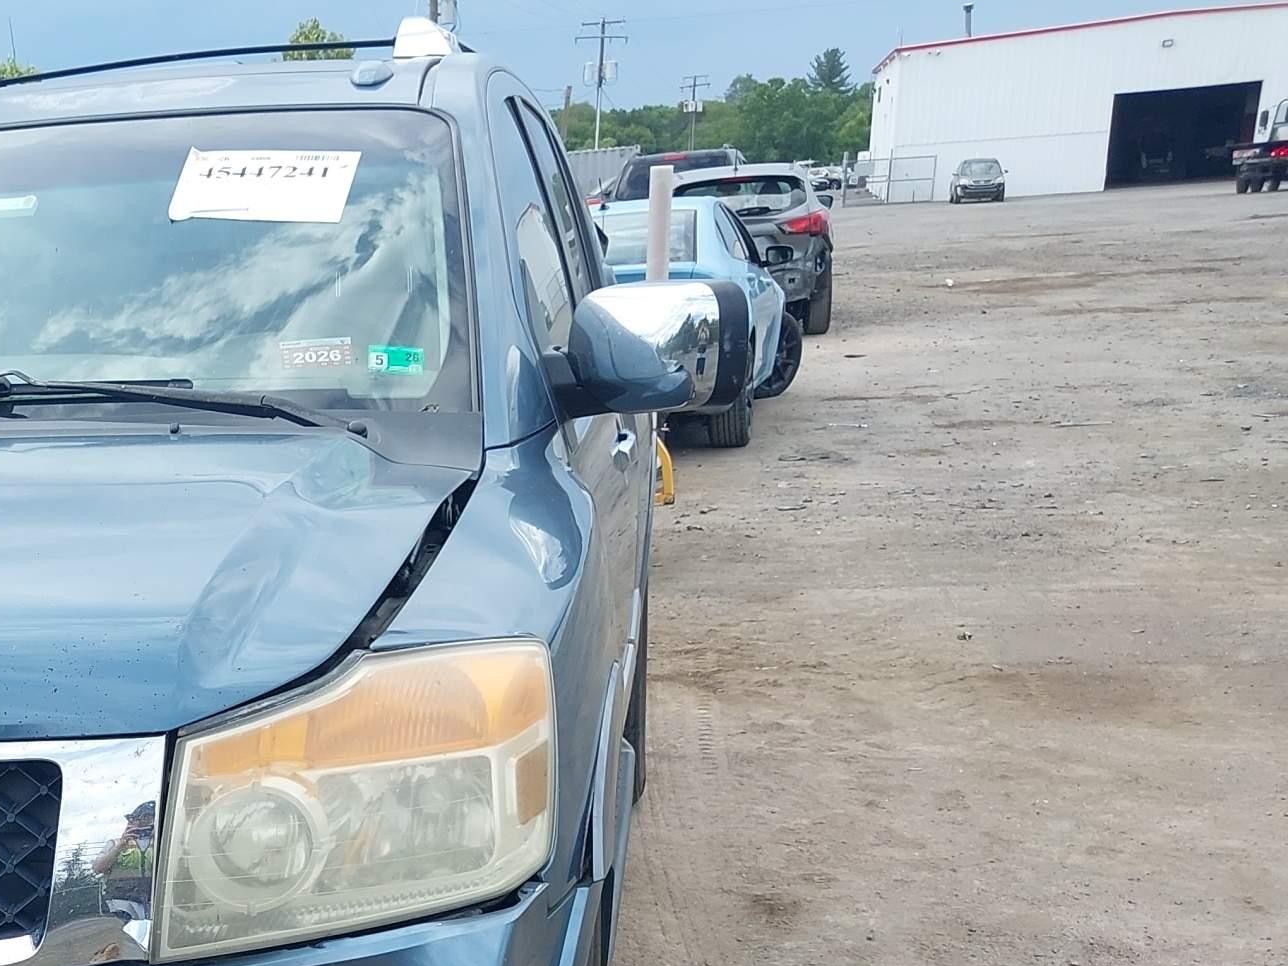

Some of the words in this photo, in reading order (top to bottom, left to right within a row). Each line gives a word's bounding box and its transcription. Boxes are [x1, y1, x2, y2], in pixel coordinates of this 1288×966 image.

[199, 165, 330, 179] 45447241
[292, 349, 342, 364] 2026
[375, 354, 384, 366] 5
[404, 351, 420, 363] 26
